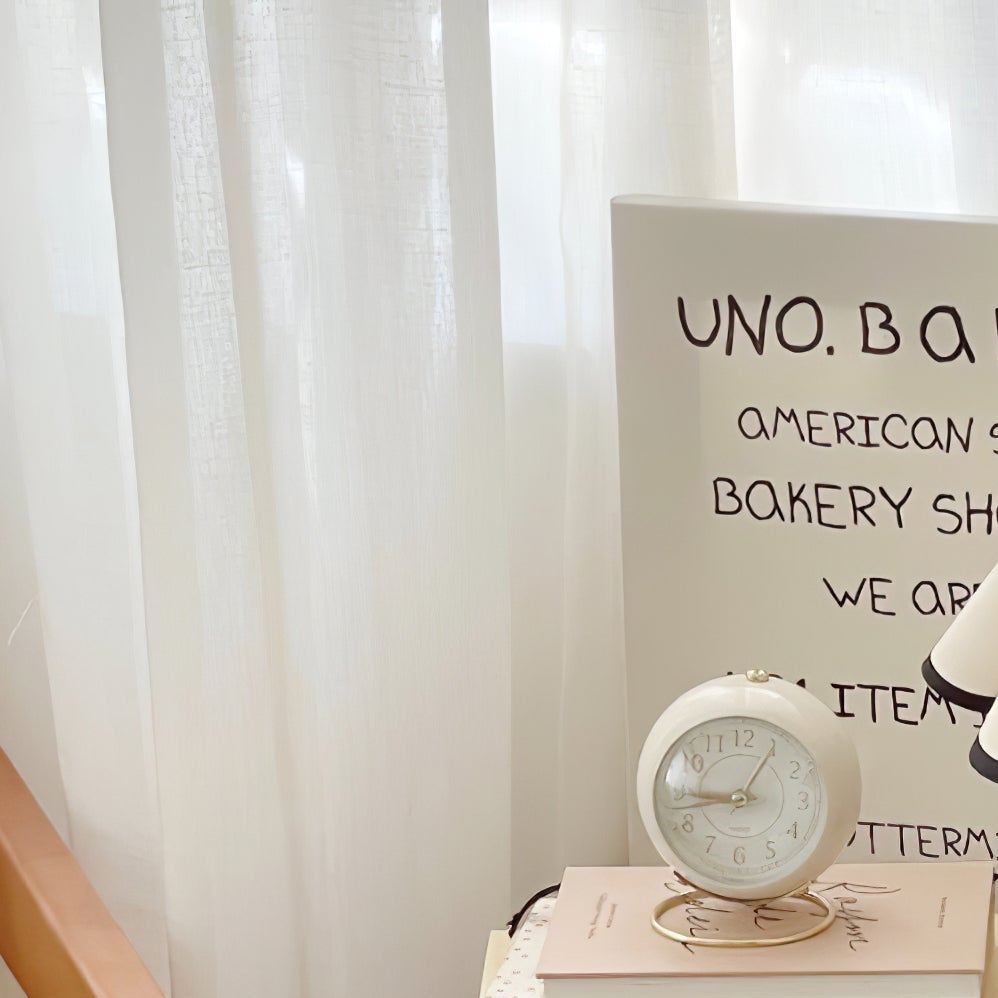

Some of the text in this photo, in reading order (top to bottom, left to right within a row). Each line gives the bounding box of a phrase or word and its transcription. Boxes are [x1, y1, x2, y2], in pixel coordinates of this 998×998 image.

[737, 406, 974, 454] AMERICAN
[712, 476, 913, 530] BAKERY
[822, 577, 981, 617] WE AR
[830, 683, 985, 728] ITEM
[705, 734, 724, 753] 11
[735, 729, 755, 748] 12
[789, 760, 802, 780] 2
[797, 791, 809, 811] 3
[705, 835, 717, 854] 7
